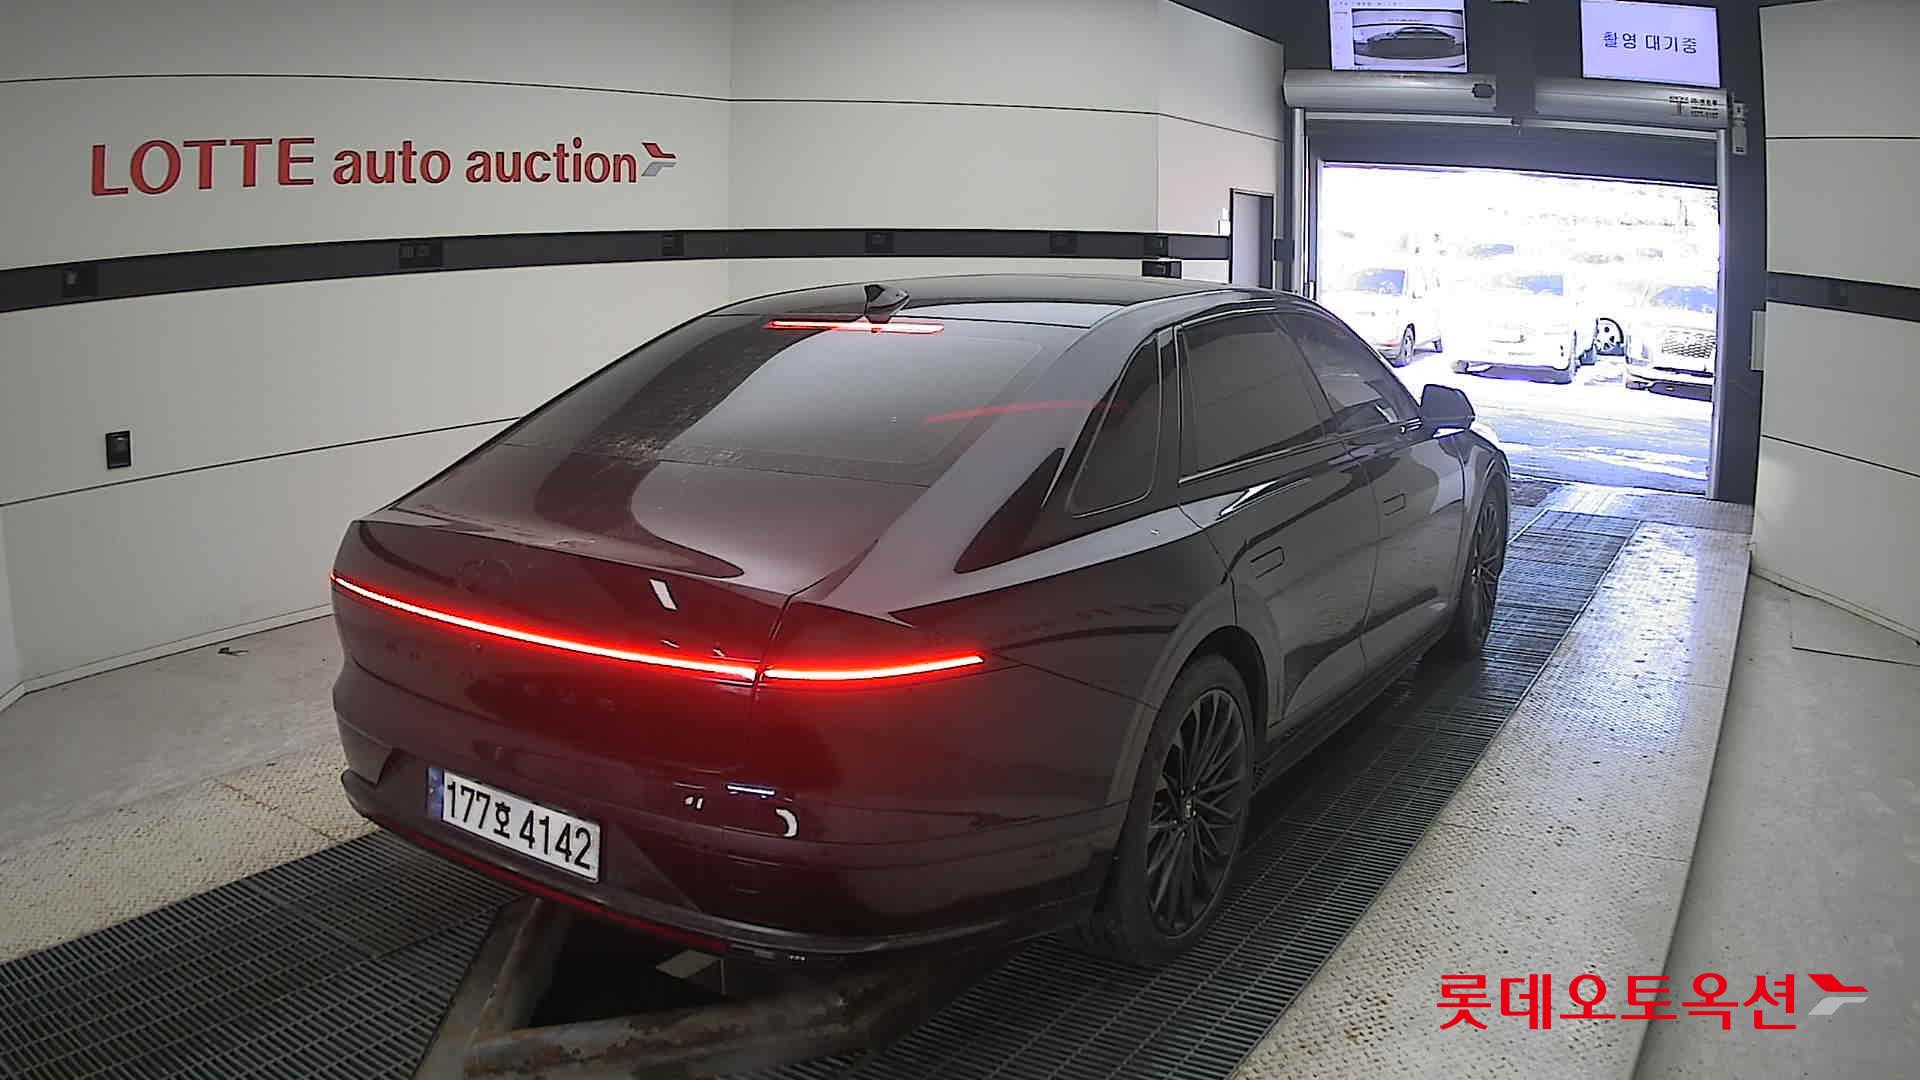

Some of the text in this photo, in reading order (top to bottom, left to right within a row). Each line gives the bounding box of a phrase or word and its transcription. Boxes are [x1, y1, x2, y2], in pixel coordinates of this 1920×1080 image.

[1644, 34, 1697, 54] 대기중
[92, 137, 638, 196] LOTTE auto auction
[447, 781, 592, 870] 177호 4142
